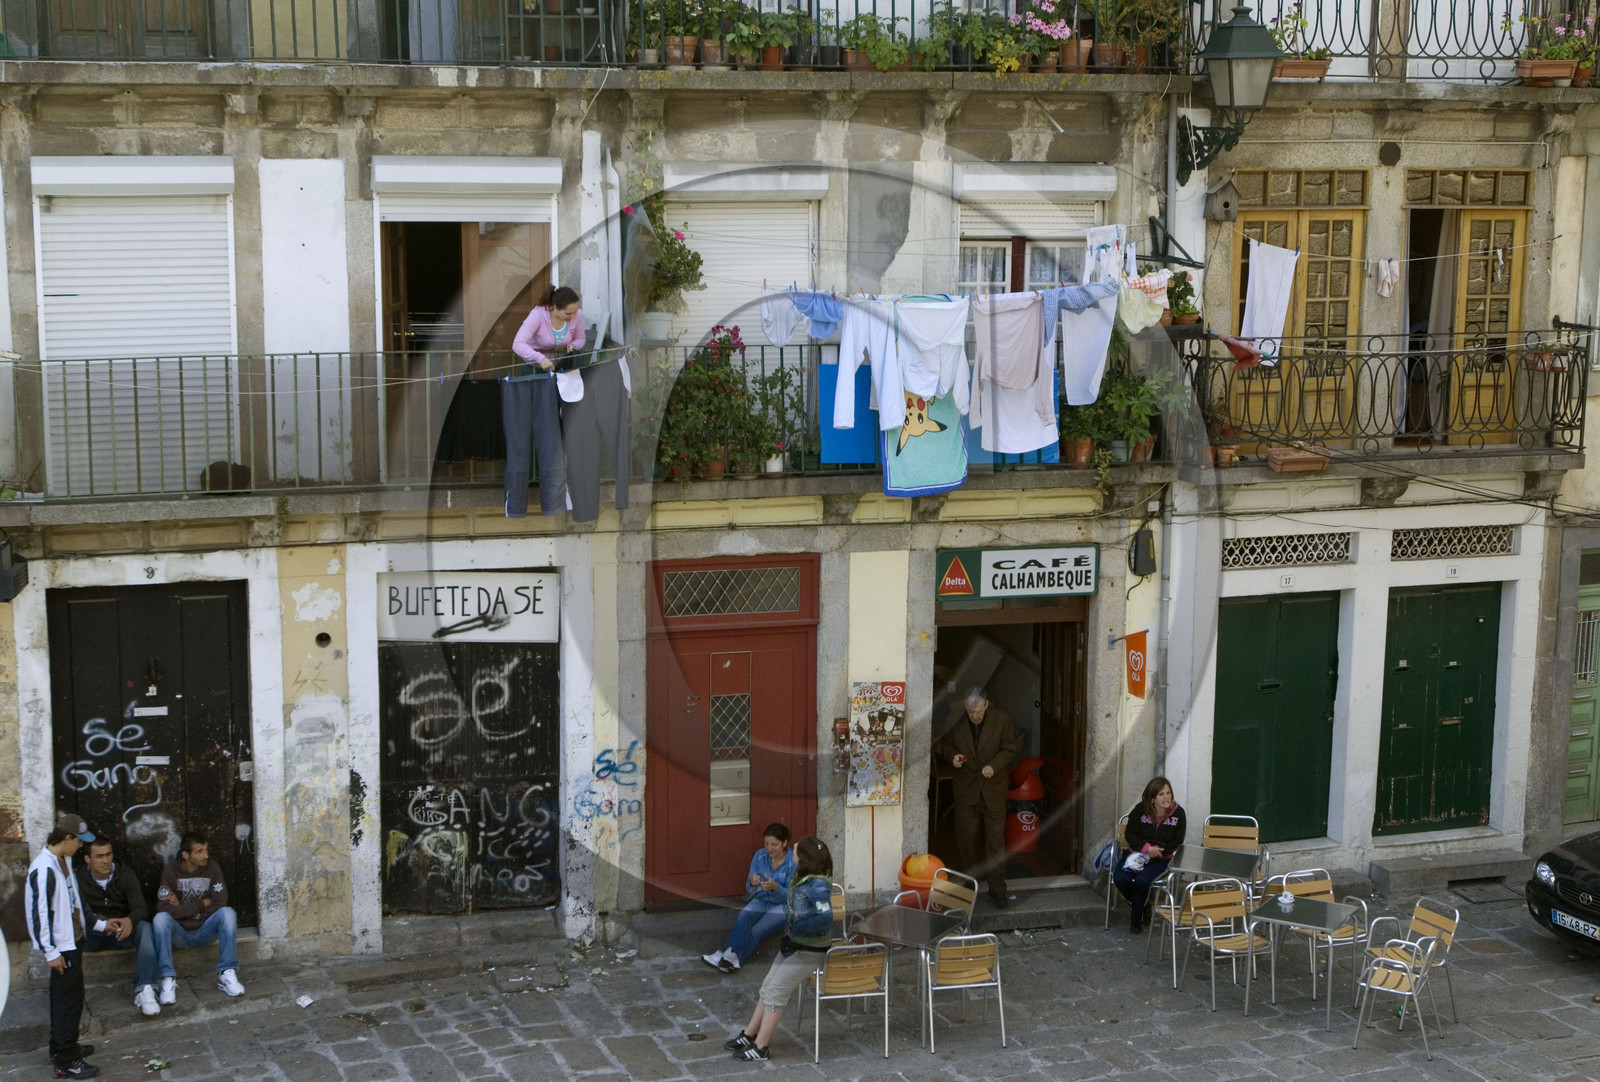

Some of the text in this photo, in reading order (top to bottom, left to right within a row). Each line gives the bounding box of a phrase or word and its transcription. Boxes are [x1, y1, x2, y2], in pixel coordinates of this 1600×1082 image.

[992, 554, 1091, 570] CAFÉ
[146, 566, 155, 580] 9
[991, 569, 1092, 590] CALHAMBEQUE
[945, 577, 966, 586] Delta
[1284, 577, 1291, 585] 17
[388, 579, 544, 616] BUFETE DA SÉ
